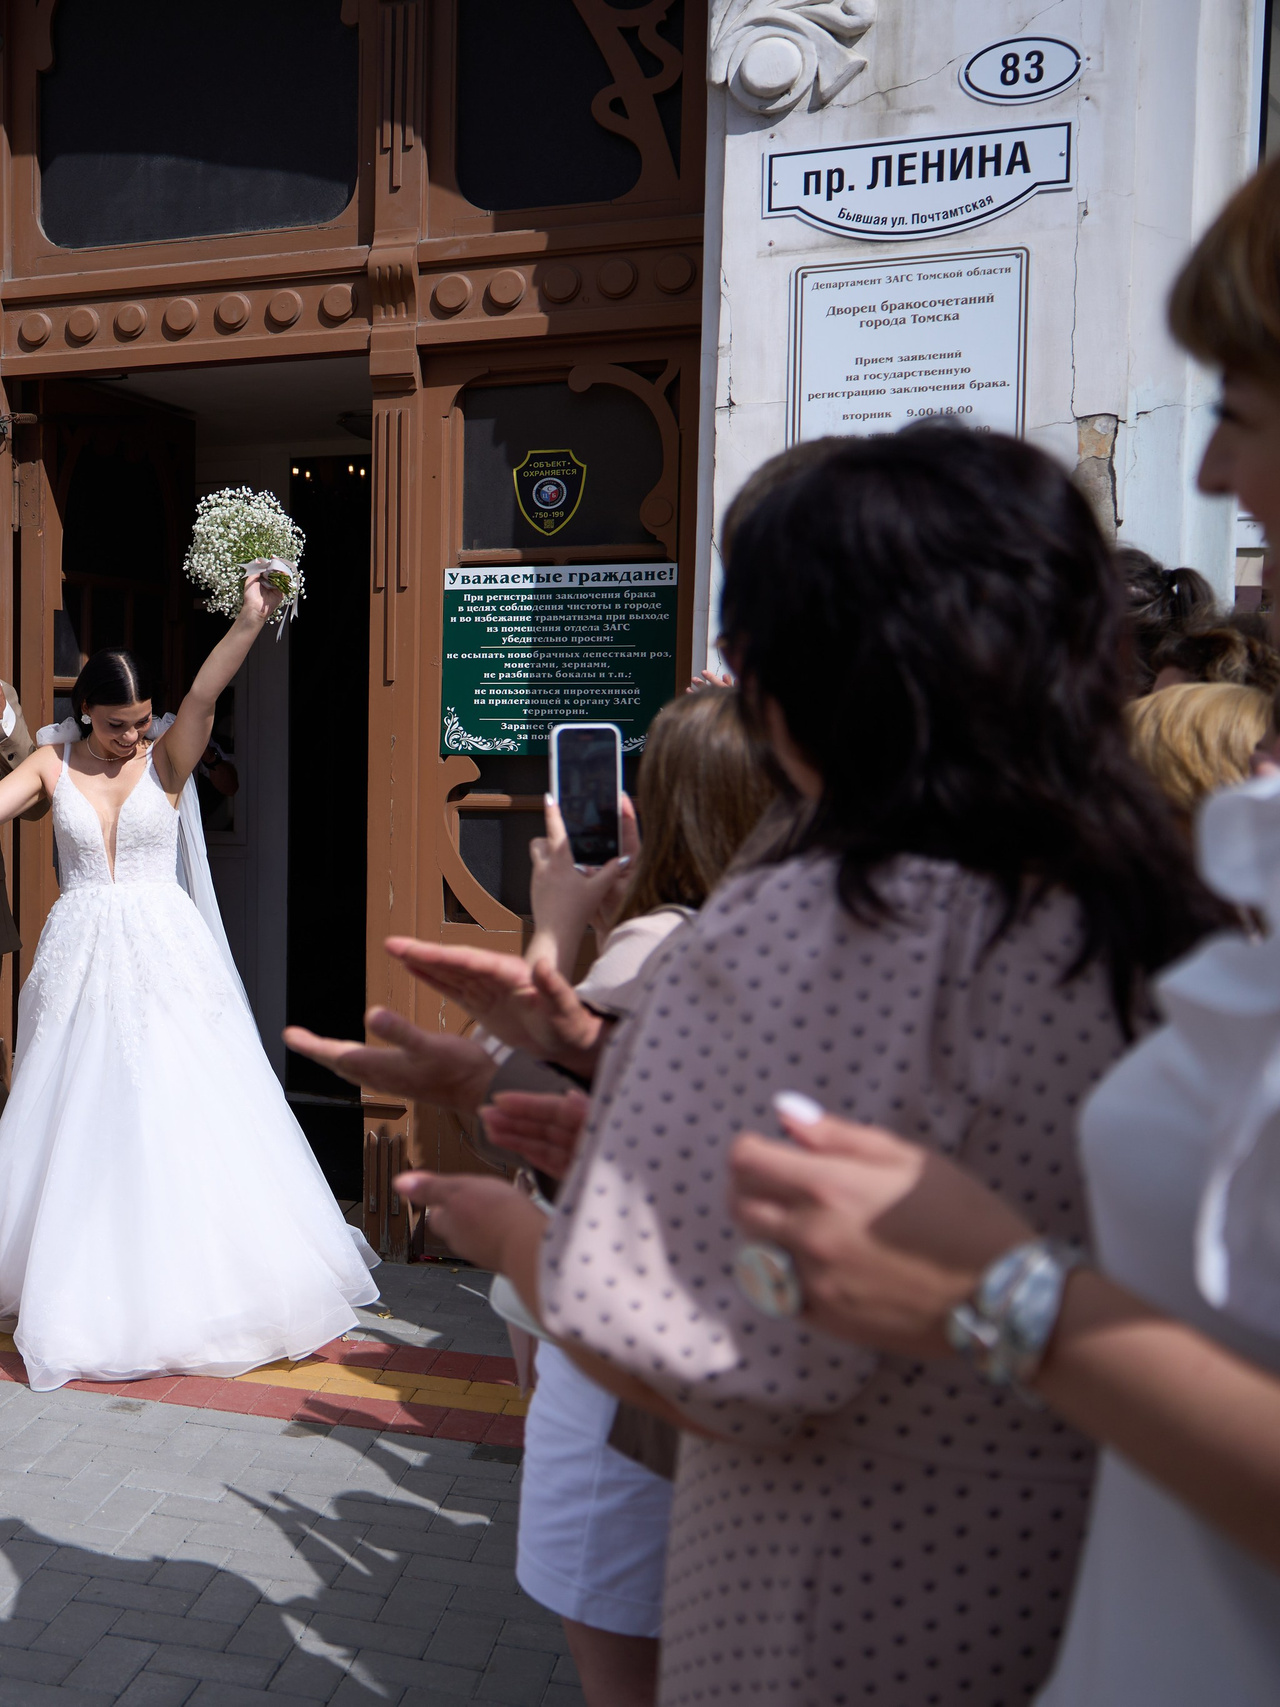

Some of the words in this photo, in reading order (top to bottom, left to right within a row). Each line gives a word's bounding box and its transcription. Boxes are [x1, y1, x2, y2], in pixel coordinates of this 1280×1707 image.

[1000, 50, 1044, 86] 83
[803, 167, 855, 201] пр.
[867, 141, 1031, 190] ЛЕНИНА
[838, 207, 888, 226] Бывшая
[891, 213, 908, 228] ул.
[911, 195, 994, 225] Почтамтская
[811, 277, 882, 291] Департамент
[885, 274, 913, 284] ЗАГС
[917, 270, 963, 282] Томской
[966, 266, 1012, 277] области
[826, 304, 876, 317] Дворец
[881, 293, 995, 313] бракосочетаний
[859, 316, 906, 329] города
[911, 312, 960, 324] Томска
[855, 355, 893, 367] Прием
[897, 350, 962, 363] заявлений
[845, 374, 859, 382] на
[864, 365, 971, 381] государственную
[808, 387, 886, 401] регистрацию
[890, 382, 965, 395] заключения
[969, 378, 1010, 390] брака.
[842, 410, 892, 421] вторник
[523, 469, 576, 477] ОХРАНЯЕТСЯ
[448, 572, 563, 585] Уважаемые
[569, 568, 674, 585] граждане!
[486, 592, 552, 603] регистрации
[555, 591, 620, 600] заключения
[623, 590, 656, 598] брака
[467, 605, 496, 613] целях
[499, 603, 563, 612] соблюдения
[567, 603, 611, 611] чистоты
[624, 602, 662, 611] городе
[474, 613, 531, 622] избежание
[534, 614, 603, 622] травматизма
[606, 614, 626, 622] при
[629, 612, 669, 621] выходе
[501, 625, 561, 633] помещения
[564, 624, 600, 633] отдела
[602, 623, 630, 632] ЗАГС
[502, 634, 568, 644] убедительно
[571, 635, 614, 643] просим:
[508, 650, 580, 659] новобрачных
[650, 651, 672, 660] роз,
[504, 662, 559, 670] монетами,
[562, 661, 610, 670] зернами,
[498, 671, 552, 680] разбивать
[555, 670, 596, 678] бокалы
[563, 687, 640, 696] пиротехникой
[488, 697, 561, 706] прилегающей
[573, 698, 610, 707] органу
[613, 697, 641, 705] ЗАГС
[522, 708, 589, 716] территории.
[501, 722, 544, 731] Заранее
